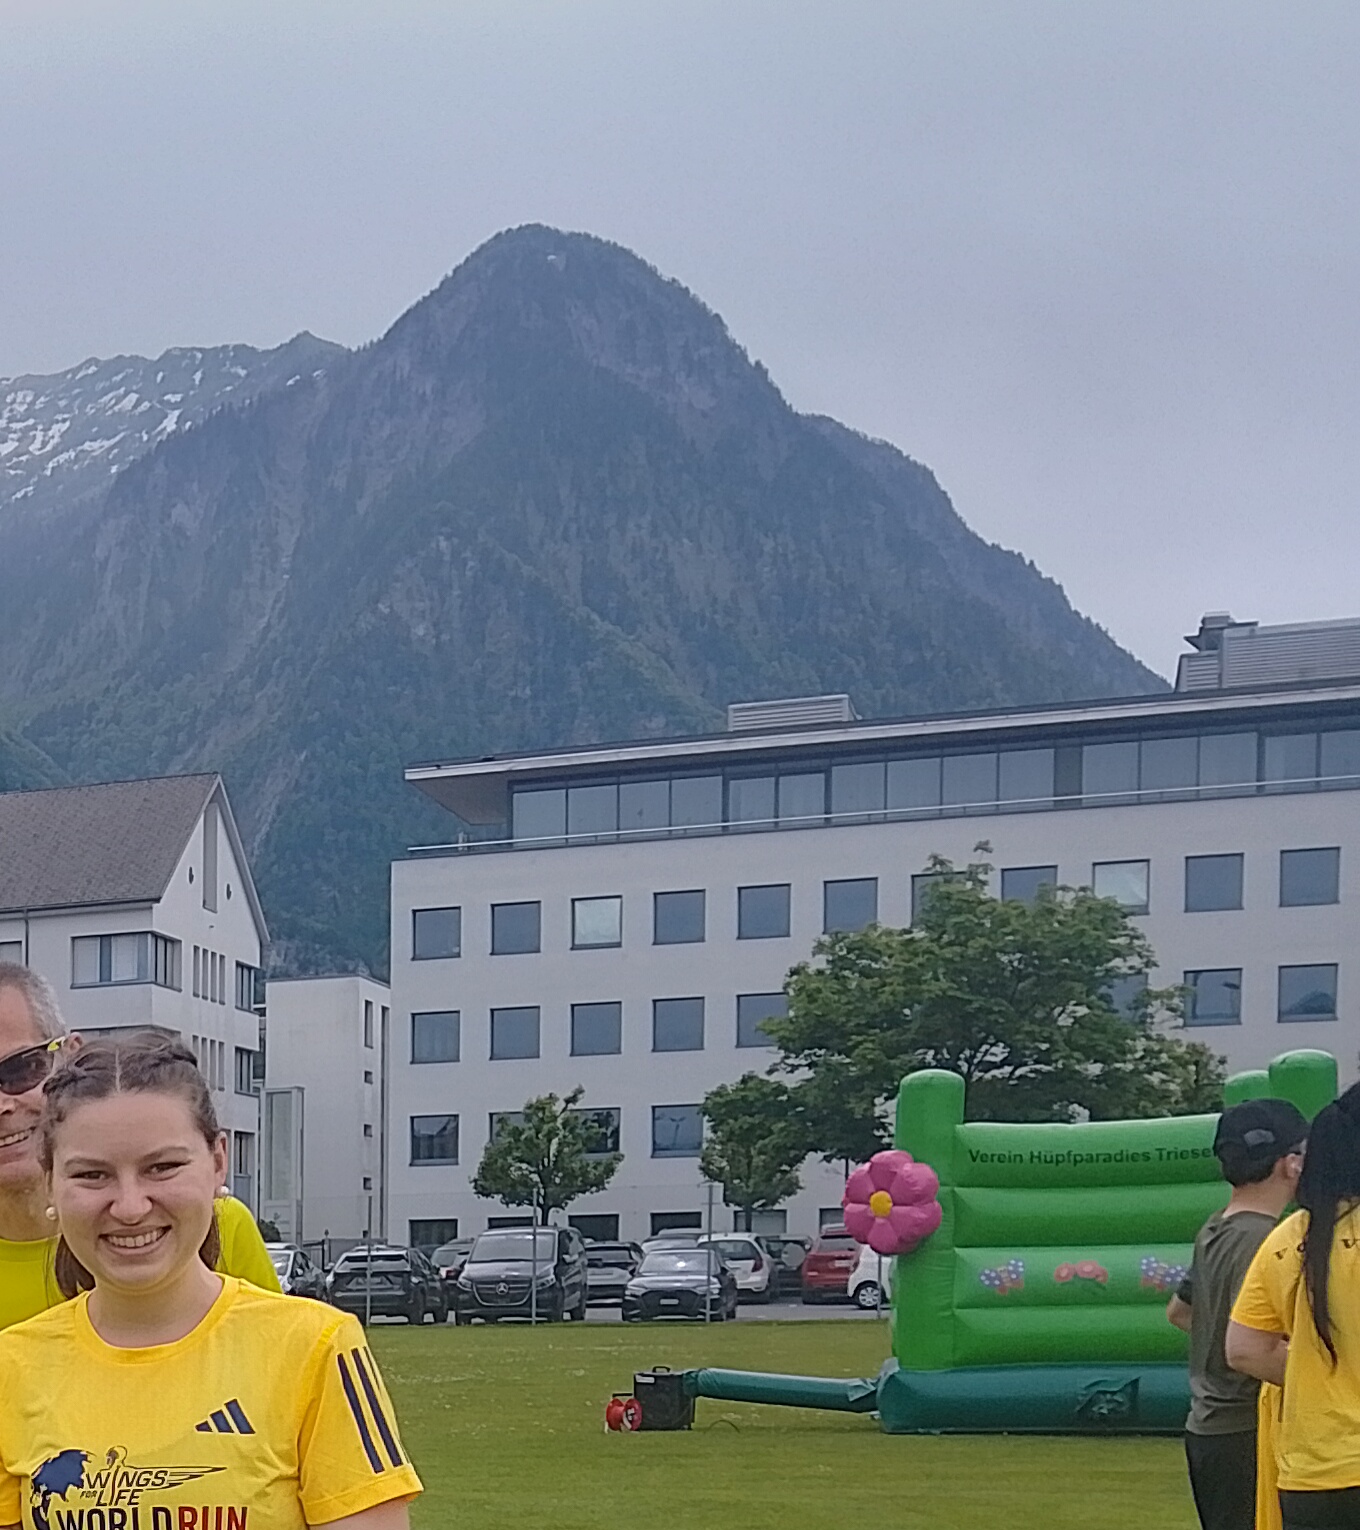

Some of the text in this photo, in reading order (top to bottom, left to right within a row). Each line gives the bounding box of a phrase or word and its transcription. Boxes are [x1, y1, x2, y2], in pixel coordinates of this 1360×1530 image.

[969, 1149, 1024, 1164] Verein
[1030, 1149, 1151, 1167] Hüpfparadies
[85, 1470, 168, 1489] WINGS
[96, 1489, 143, 1506] LIFE
